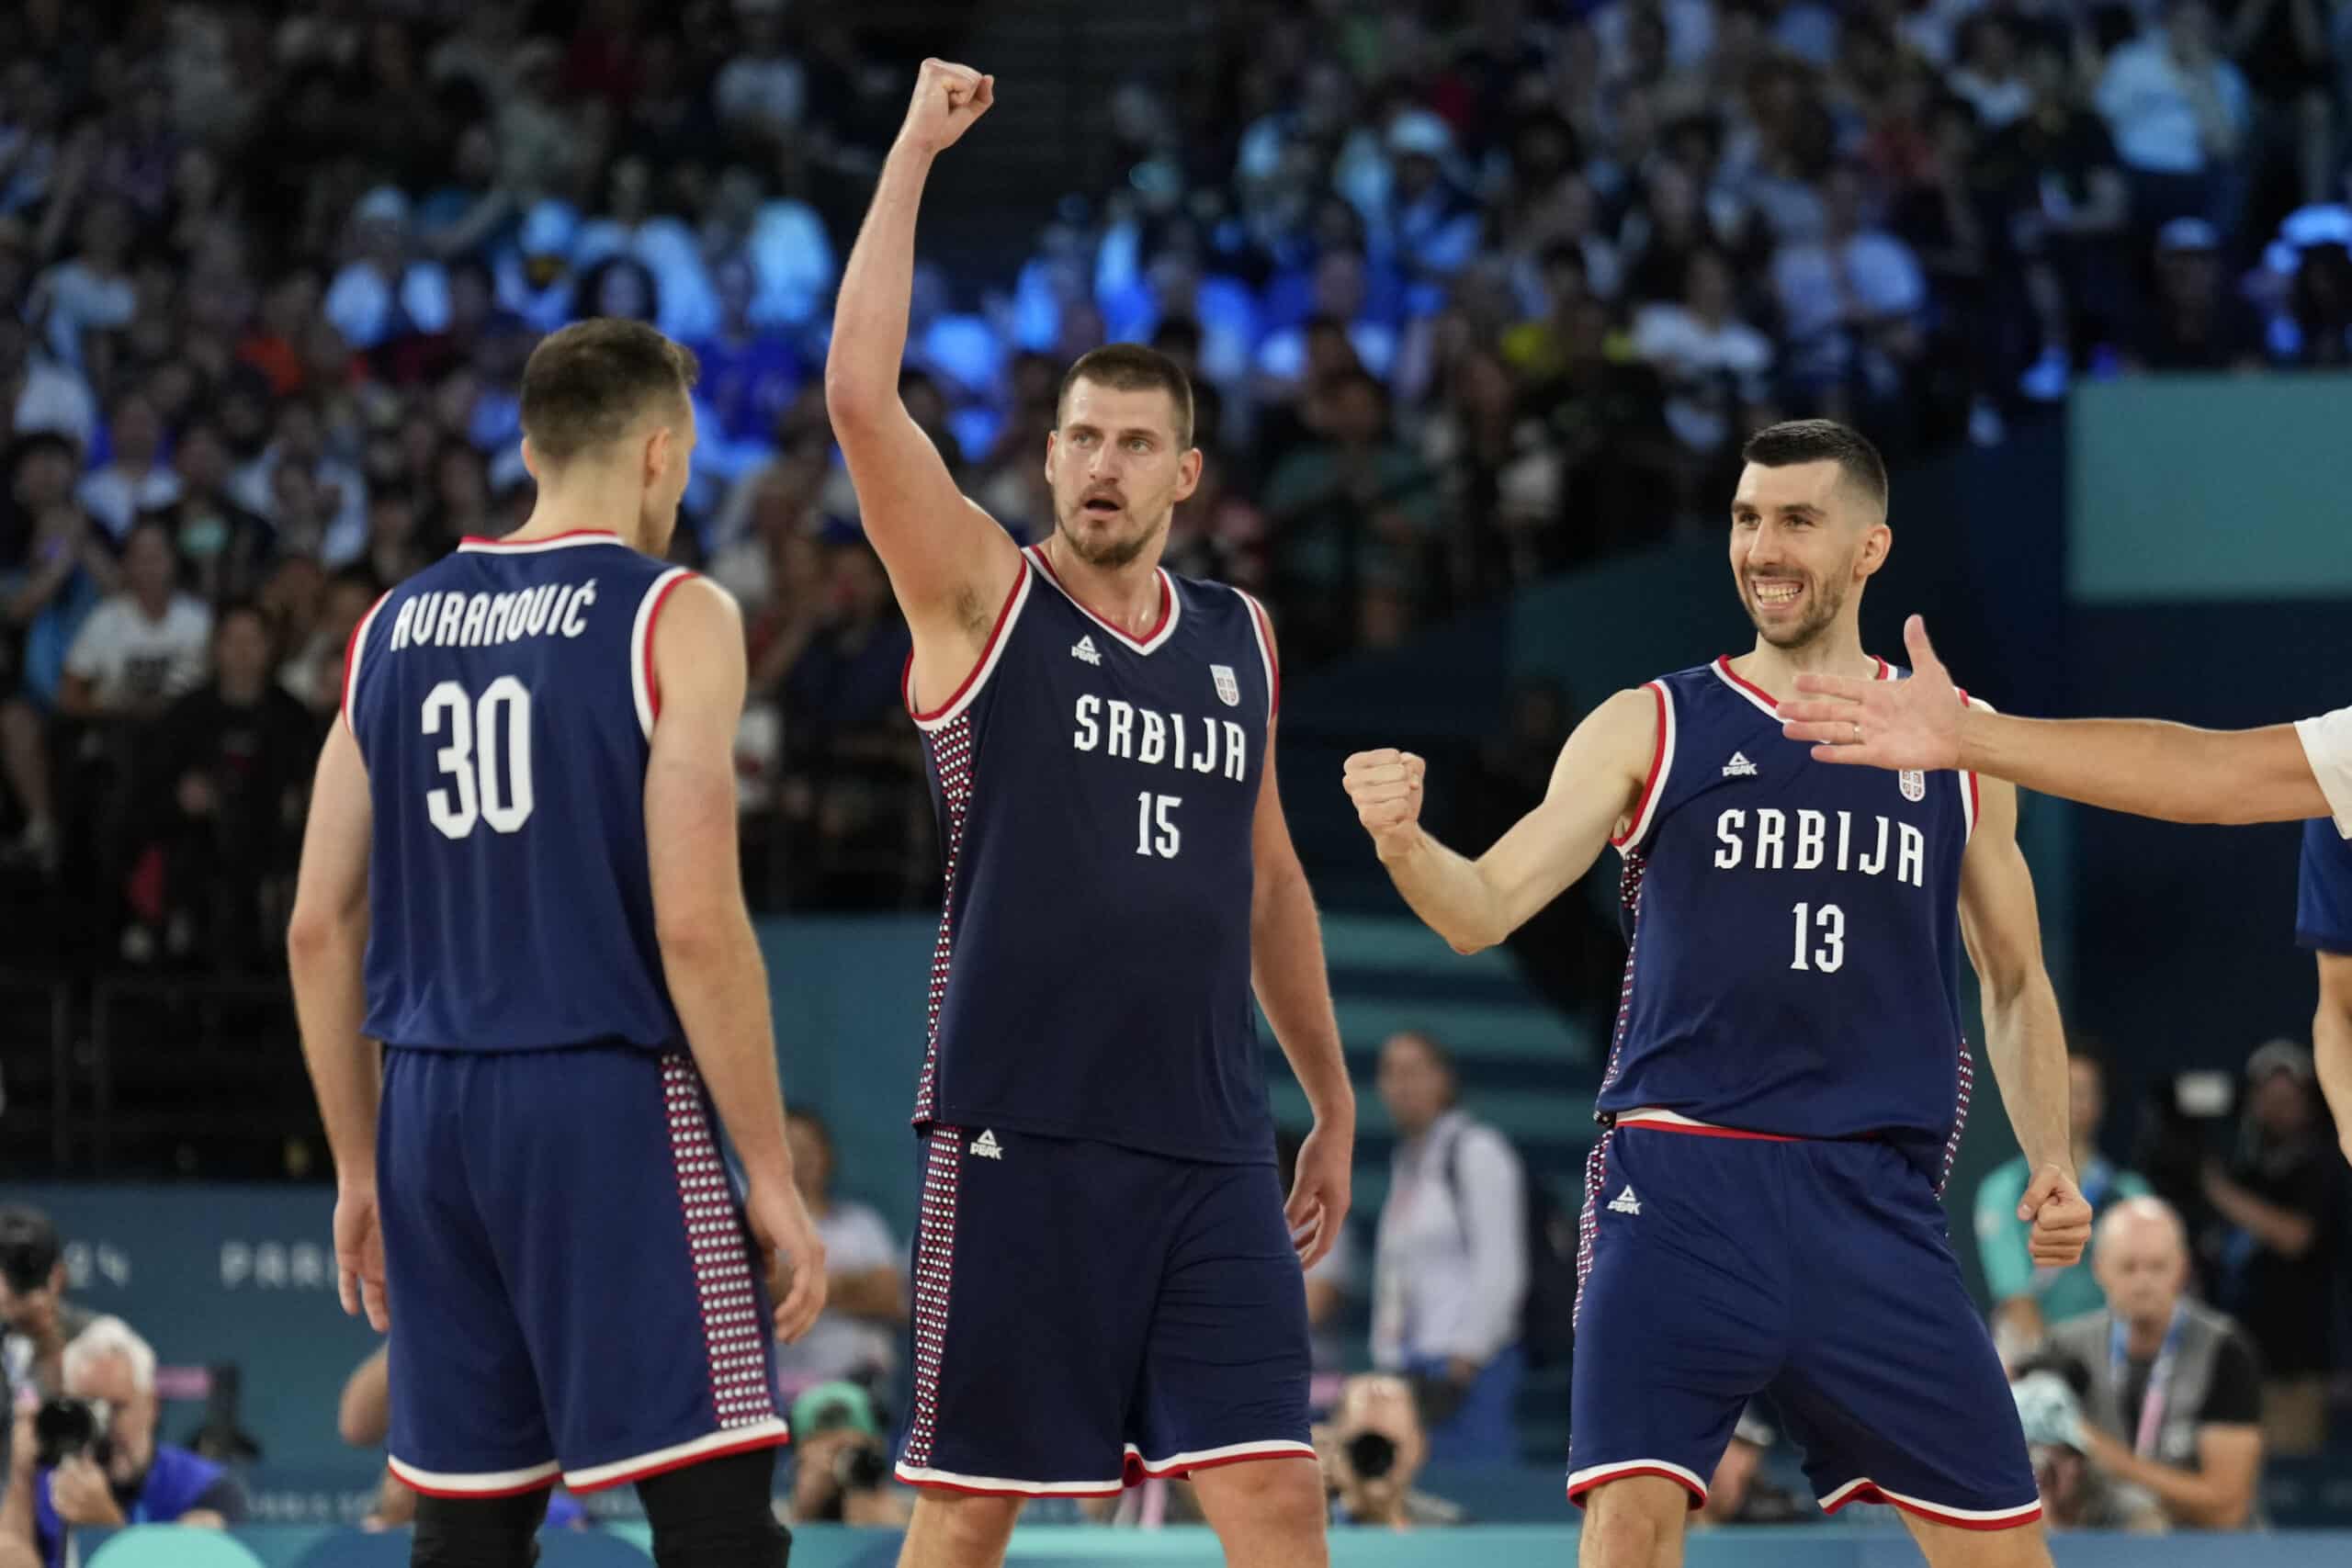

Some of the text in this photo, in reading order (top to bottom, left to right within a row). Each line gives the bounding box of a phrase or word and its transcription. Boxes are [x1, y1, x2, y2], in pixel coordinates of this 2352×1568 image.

[421, 675, 534, 840] 30
[1073, 694, 1246, 782] SRBIJA
[1136, 791, 1182, 859] 15
[1713, 808, 1925, 887] SRBIJA
[1790, 902, 1845, 974] 13
